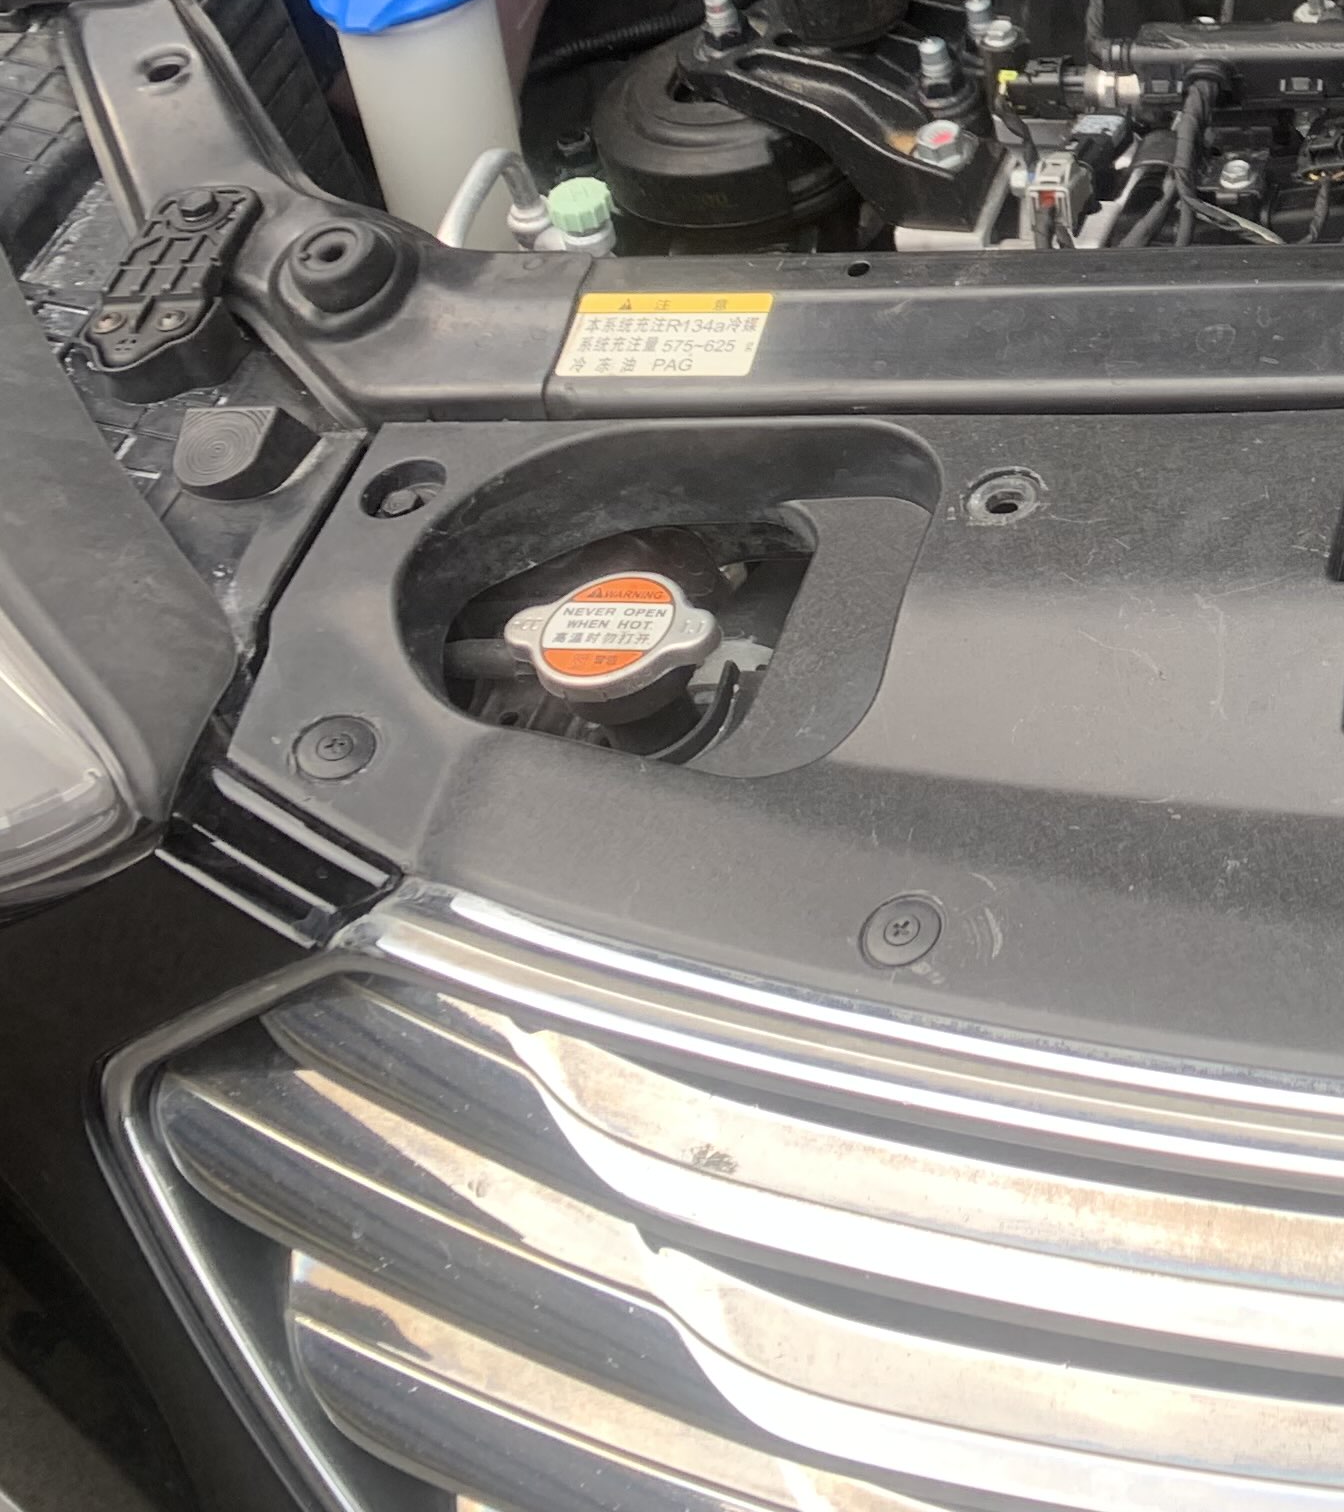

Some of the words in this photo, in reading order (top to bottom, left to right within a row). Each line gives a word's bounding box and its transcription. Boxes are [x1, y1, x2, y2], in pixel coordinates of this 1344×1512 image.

[651, 358, 695, 372] PAG
[604, 589, 664, 600] WARNING
[563, 607, 617, 617] NEVER
[623, 608, 668, 618] OPEN
[567, 619, 610, 629] WHEN
